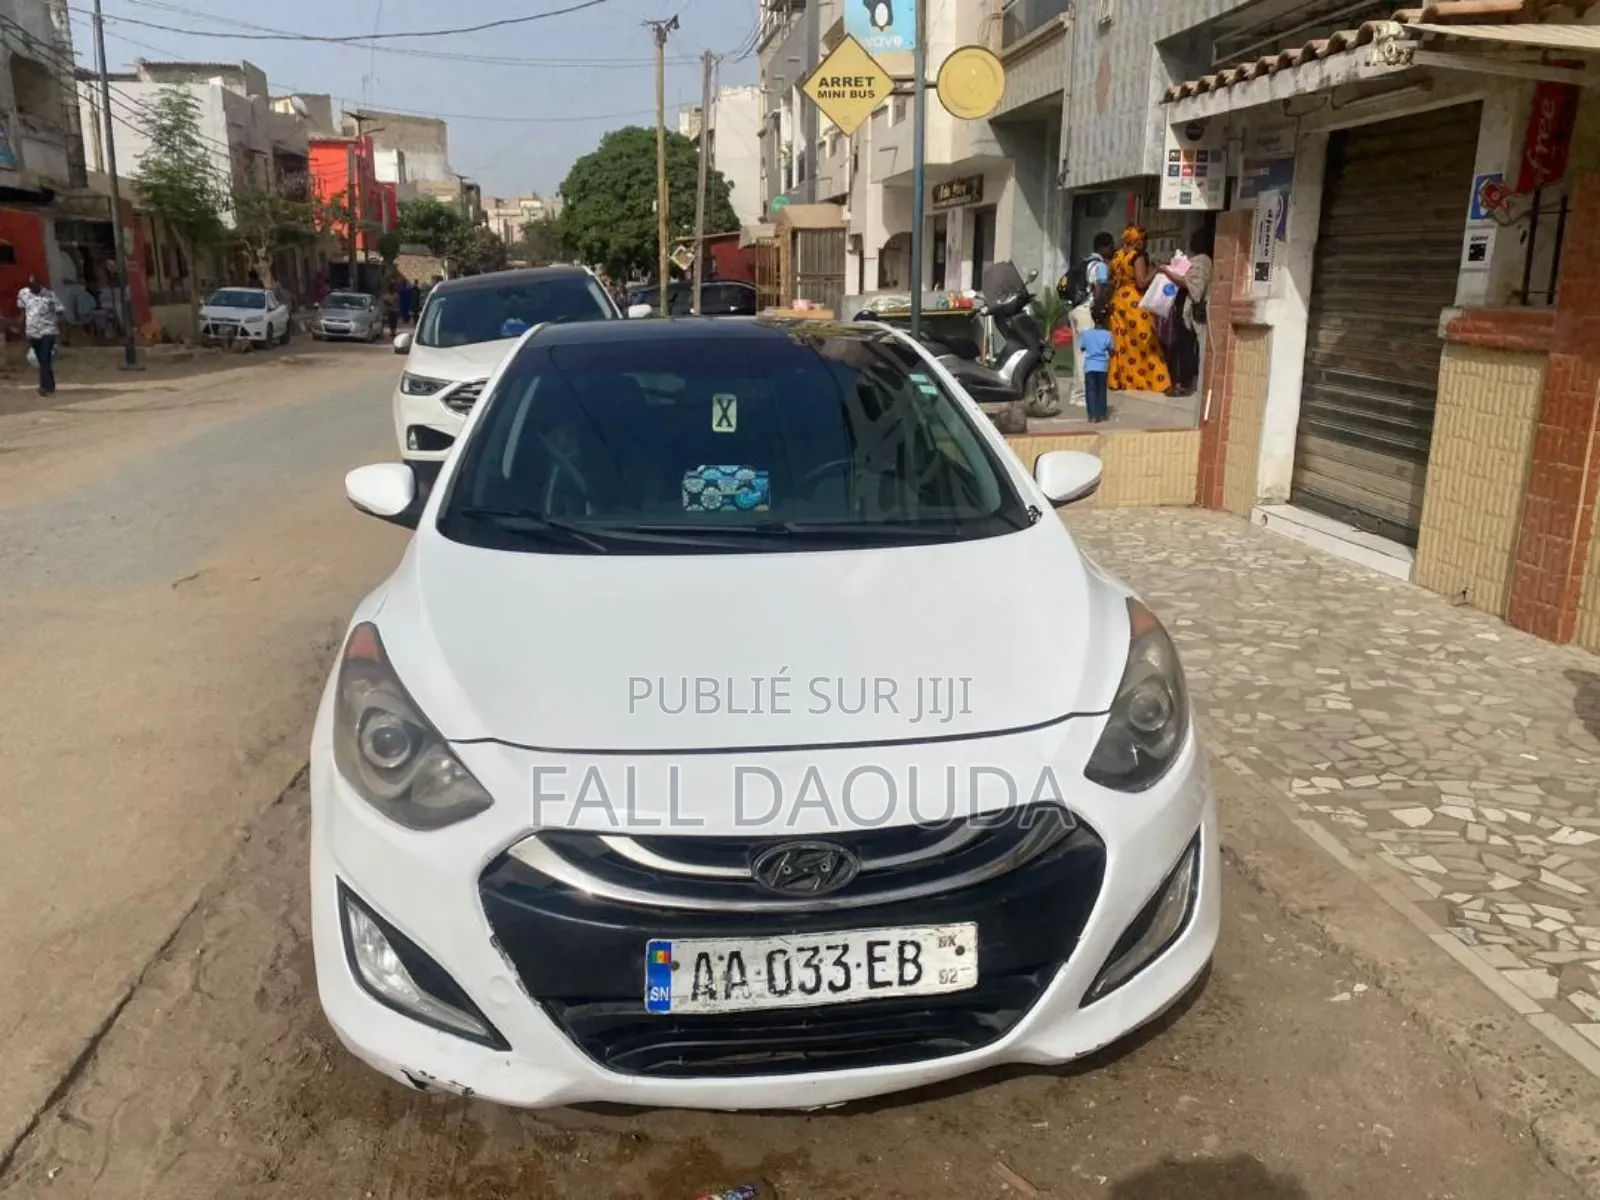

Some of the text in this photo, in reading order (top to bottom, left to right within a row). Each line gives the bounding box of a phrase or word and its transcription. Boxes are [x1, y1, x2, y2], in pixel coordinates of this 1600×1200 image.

[818, 76, 876, 88] ARRET
[817, 90, 876, 99] MINI BUS
[1527, 98, 1556, 176] free
[715, 398, 735, 428] X
[650, 986, 669, 1001] SN
